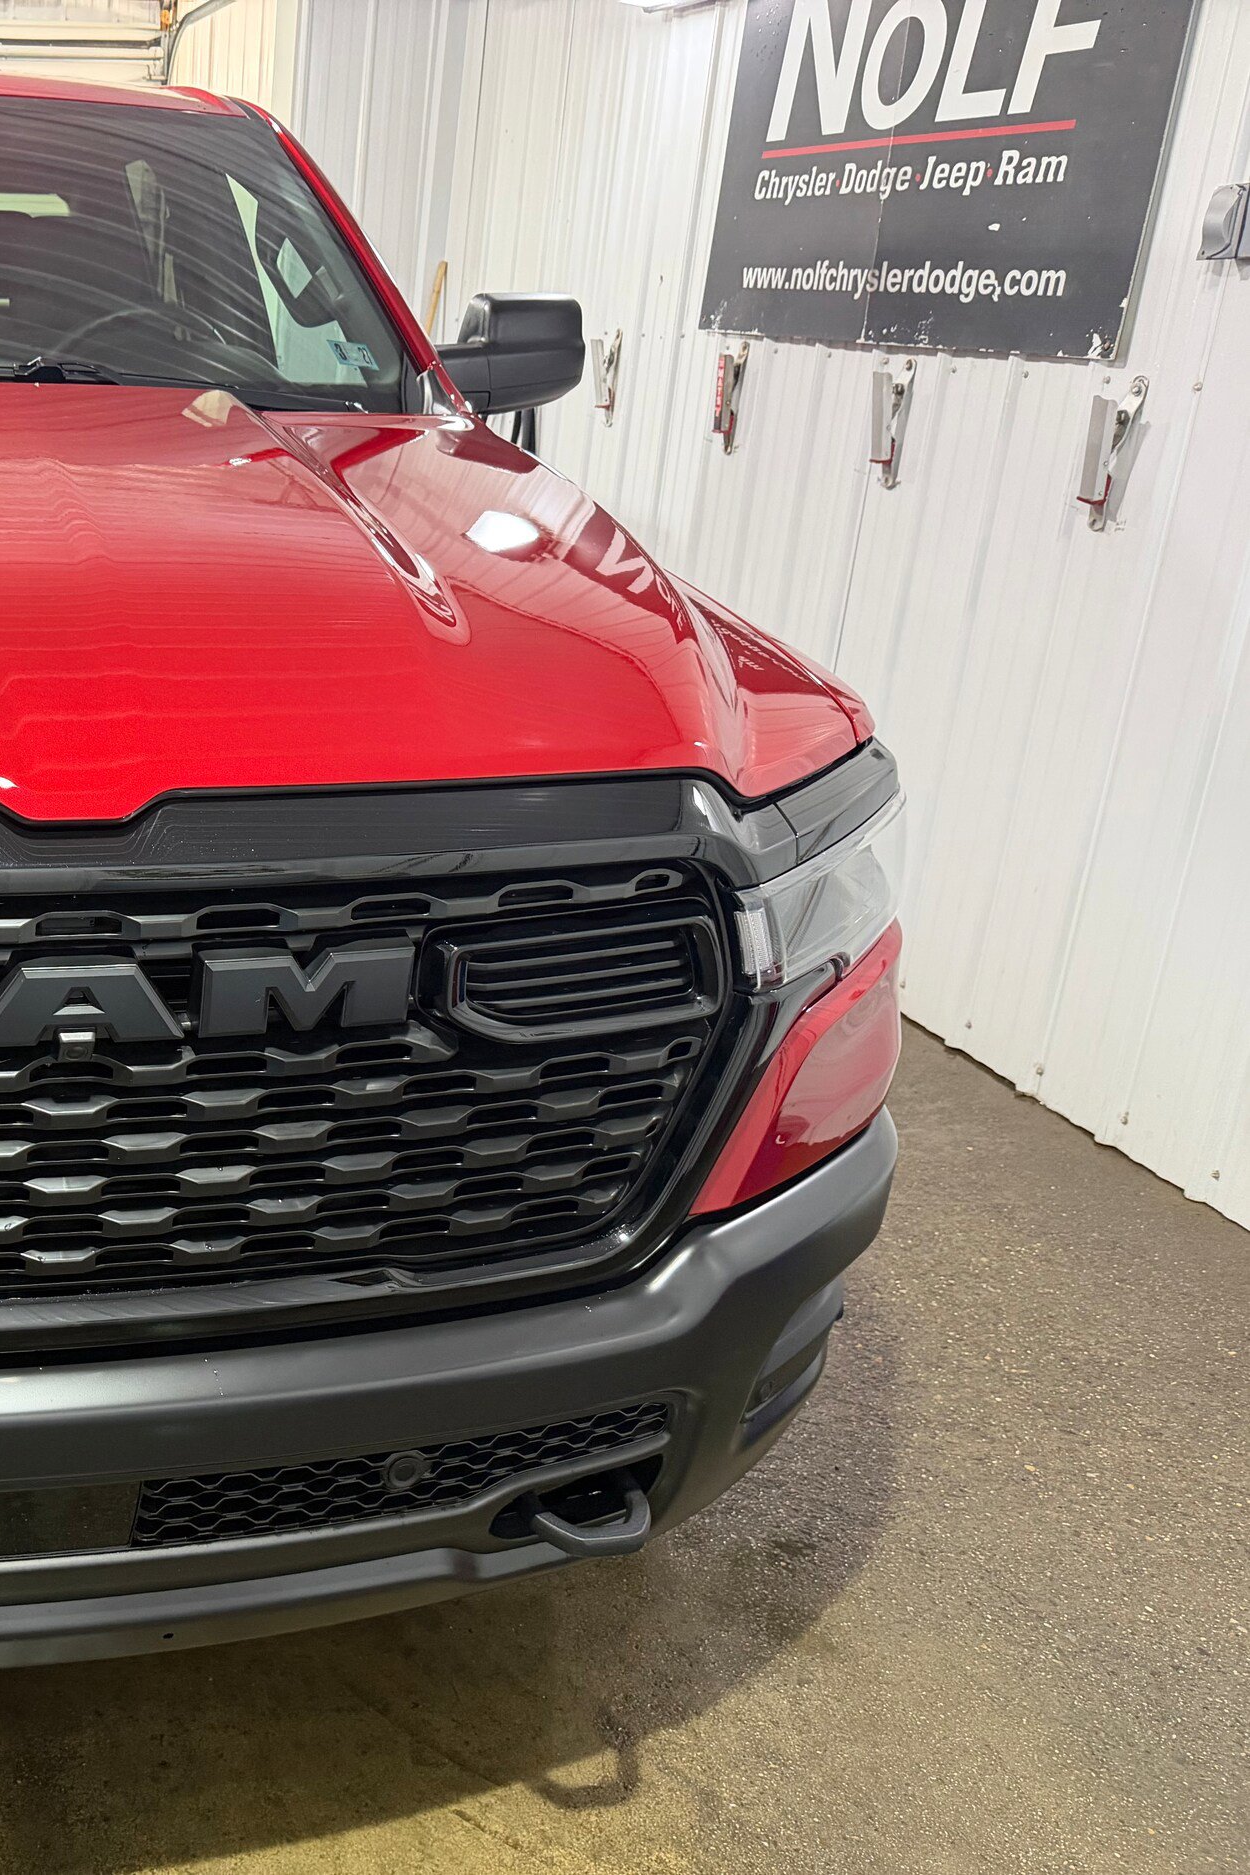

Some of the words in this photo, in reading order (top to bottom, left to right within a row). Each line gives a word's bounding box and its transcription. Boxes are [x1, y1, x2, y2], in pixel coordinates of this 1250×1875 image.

[766, 0, 1101, 141] NOLF
[755, 169, 837, 205] Chrysler
[840, 161, 912, 199] Dodge
[919, 155, 989, 194] Jeep
[995, 149, 1068, 186] Ram
[742, 261, 1067, 301] www.nolfchryslerdodge.com
